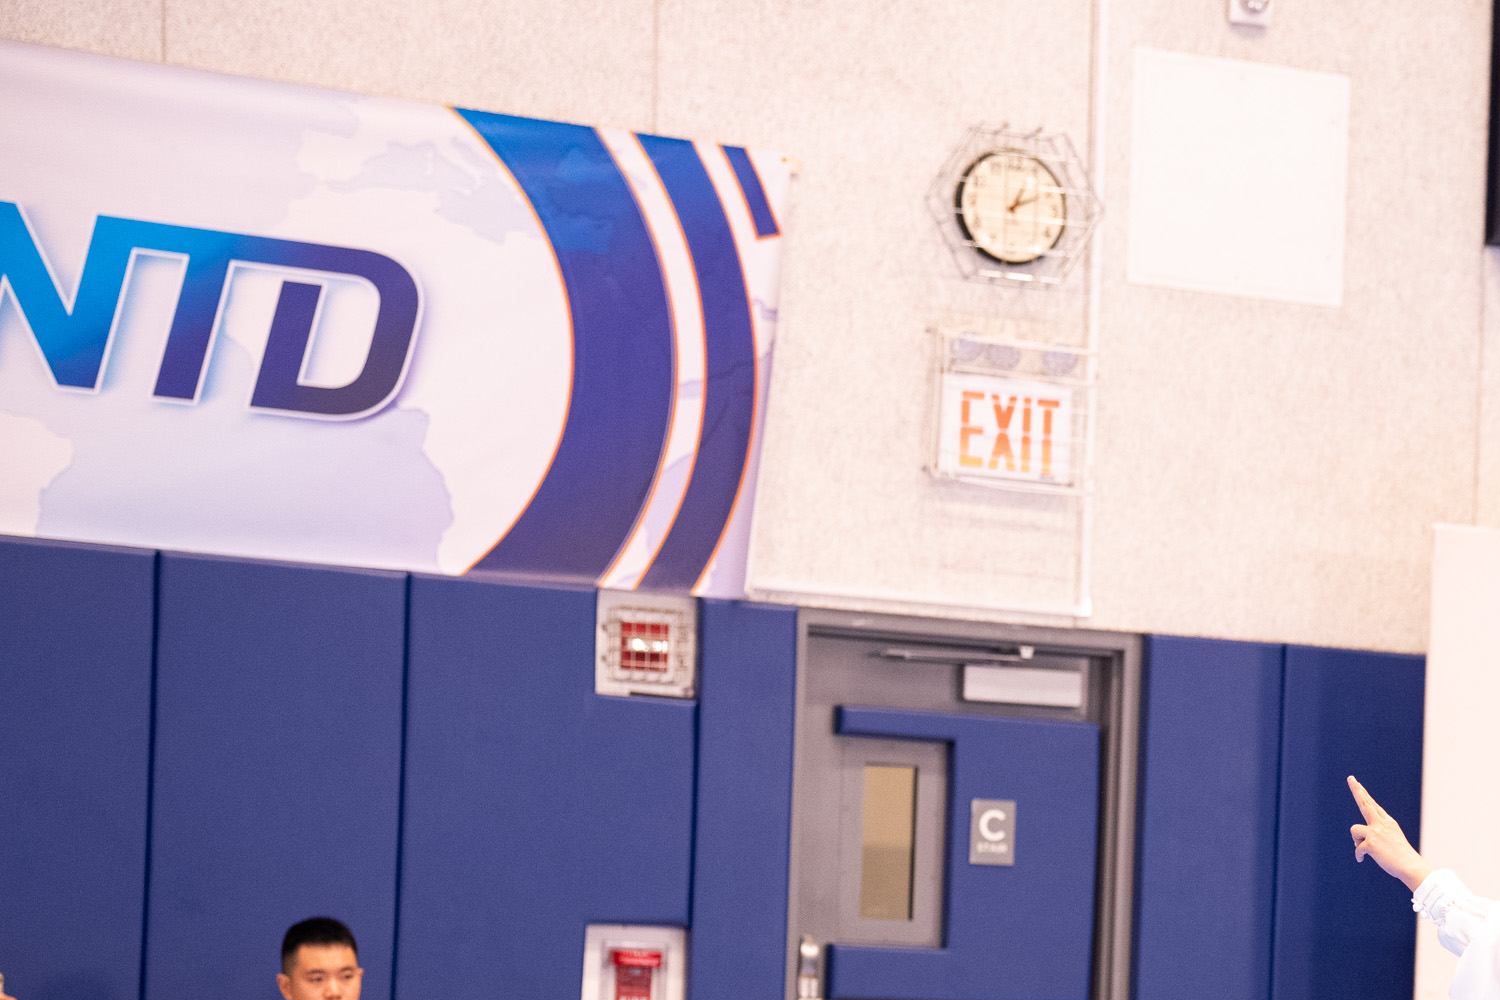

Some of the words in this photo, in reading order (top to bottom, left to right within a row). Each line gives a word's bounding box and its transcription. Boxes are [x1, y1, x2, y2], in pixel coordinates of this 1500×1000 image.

[0, 200, 424, 418] NTD
[958, 389, 1061, 477] EXIT
[979, 808, 1006, 842] C
